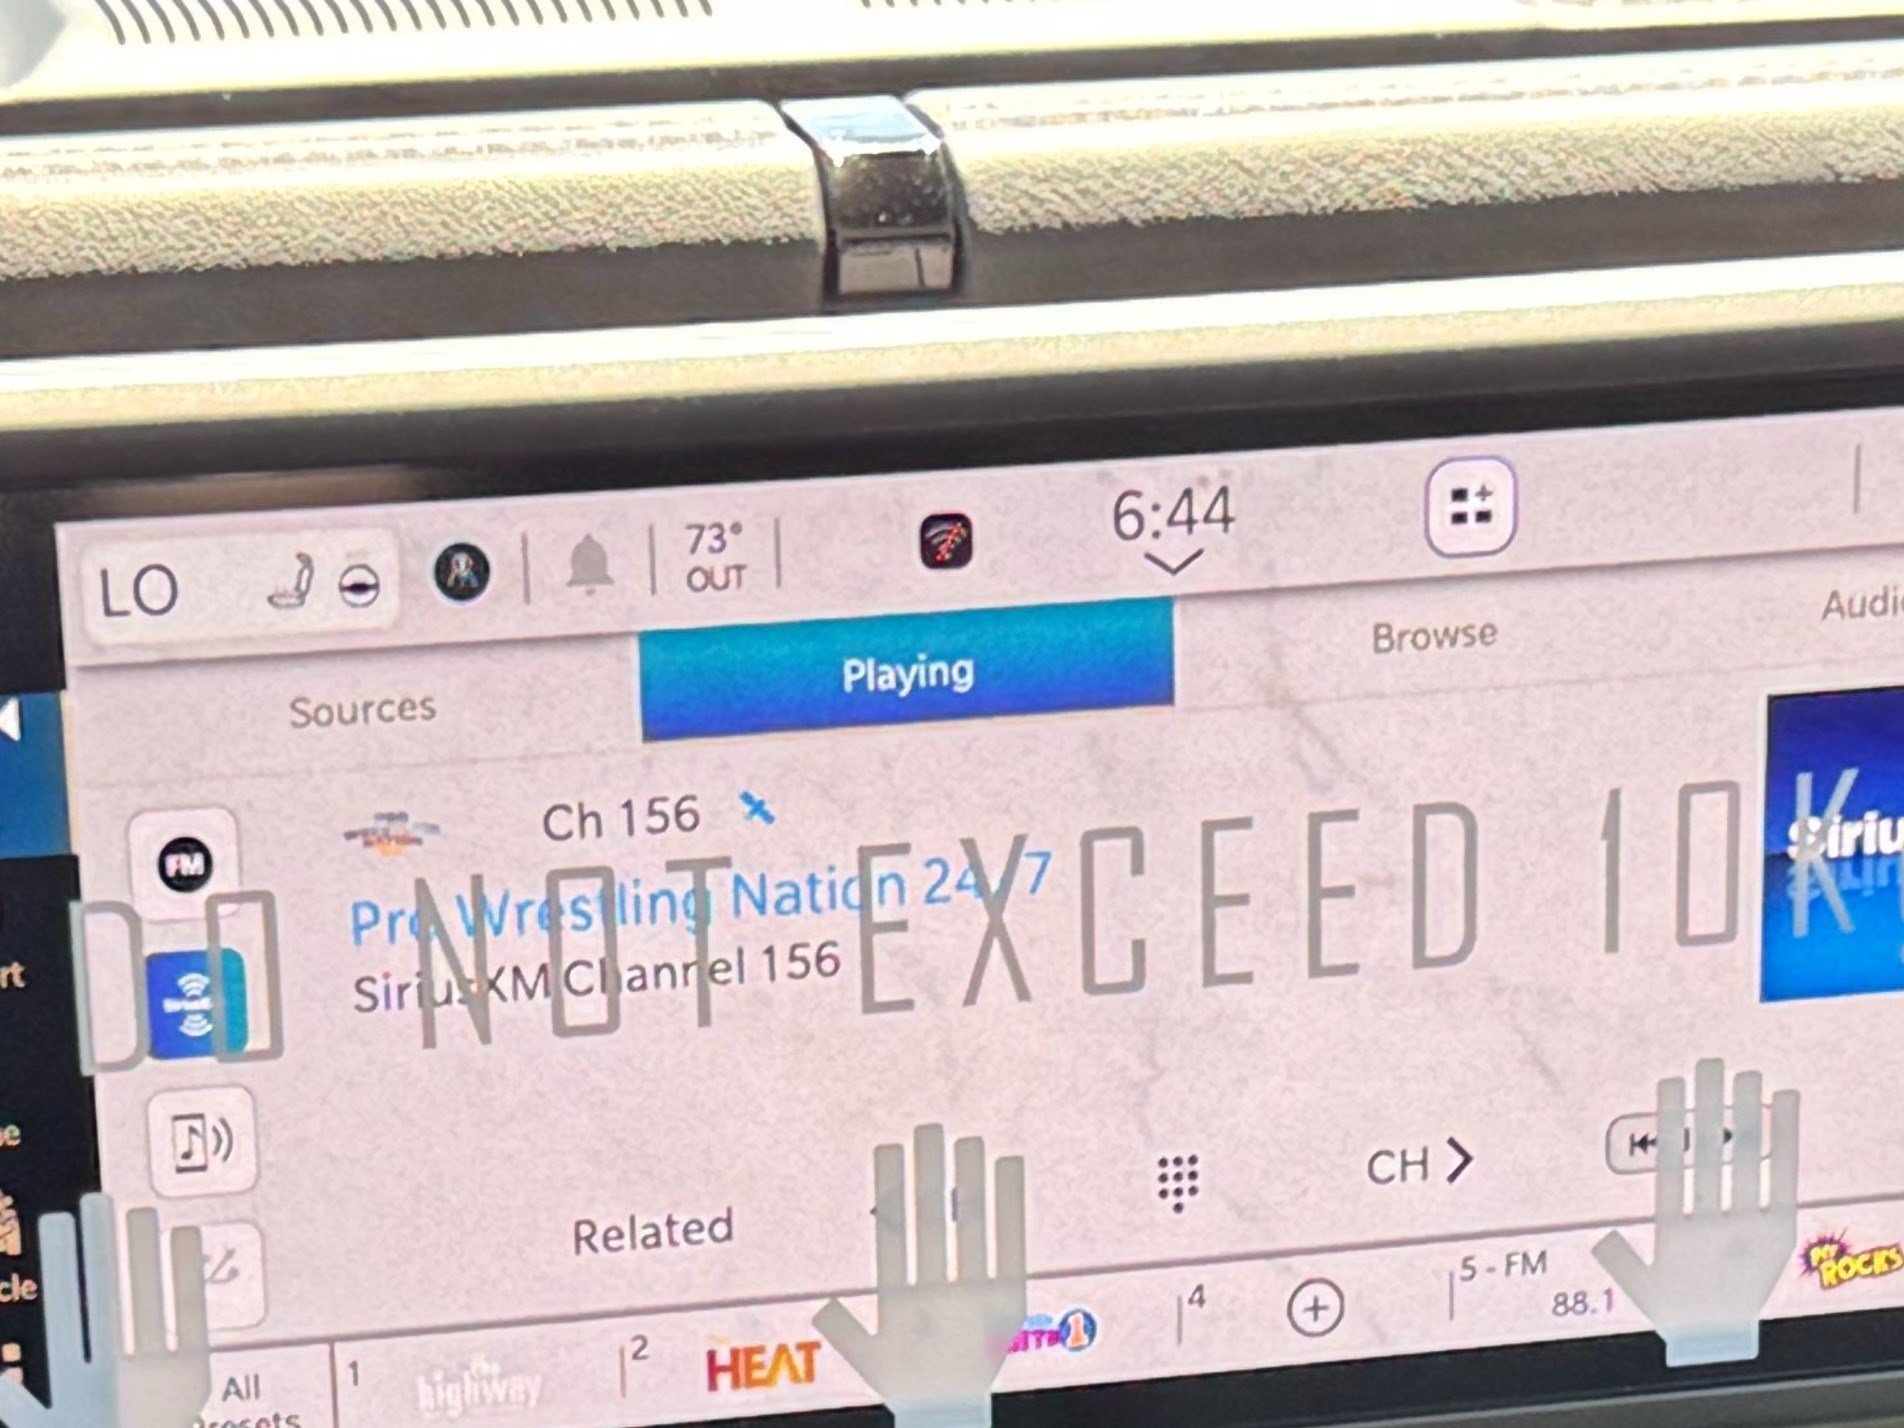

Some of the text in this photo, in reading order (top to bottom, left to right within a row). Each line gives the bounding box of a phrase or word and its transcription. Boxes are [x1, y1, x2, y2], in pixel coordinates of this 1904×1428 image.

[1112, 485, 1235, 541] 6:44
[685, 522, 742, 555] 73°
[101, 564, 178, 617] LO
[687, 564, 746, 592] OUT
[1373, 621, 1497, 655] Browse
[844, 654, 974, 696] Playing
[290, 695, 436, 729] Sources
[543, 795, 700, 842] Ch 156
[164, 853, 204, 877] FM
[923, 850, 1052, 904] 247
[414, 855, 732, 1049] NOT
[858, 801, 1478, 1014] EXCEED
[764, 940, 840, 983] 156
[1367, 1146, 1428, 1184] CH
[574, 1207, 734, 1256] Related
[1459, 1256, 1477, 1281] 5
[1504, 1250, 1547, 1277] FM
[1188, 1284, 1206, 1308] 4
[1551, 1287, 1613, 1317] 88.1
[630, 1335, 649, 1360] 2
[349, 1360, 359, 1386] 1
[707, 1341, 821, 1392] HEAT
[223, 1375, 260, 1399] All
